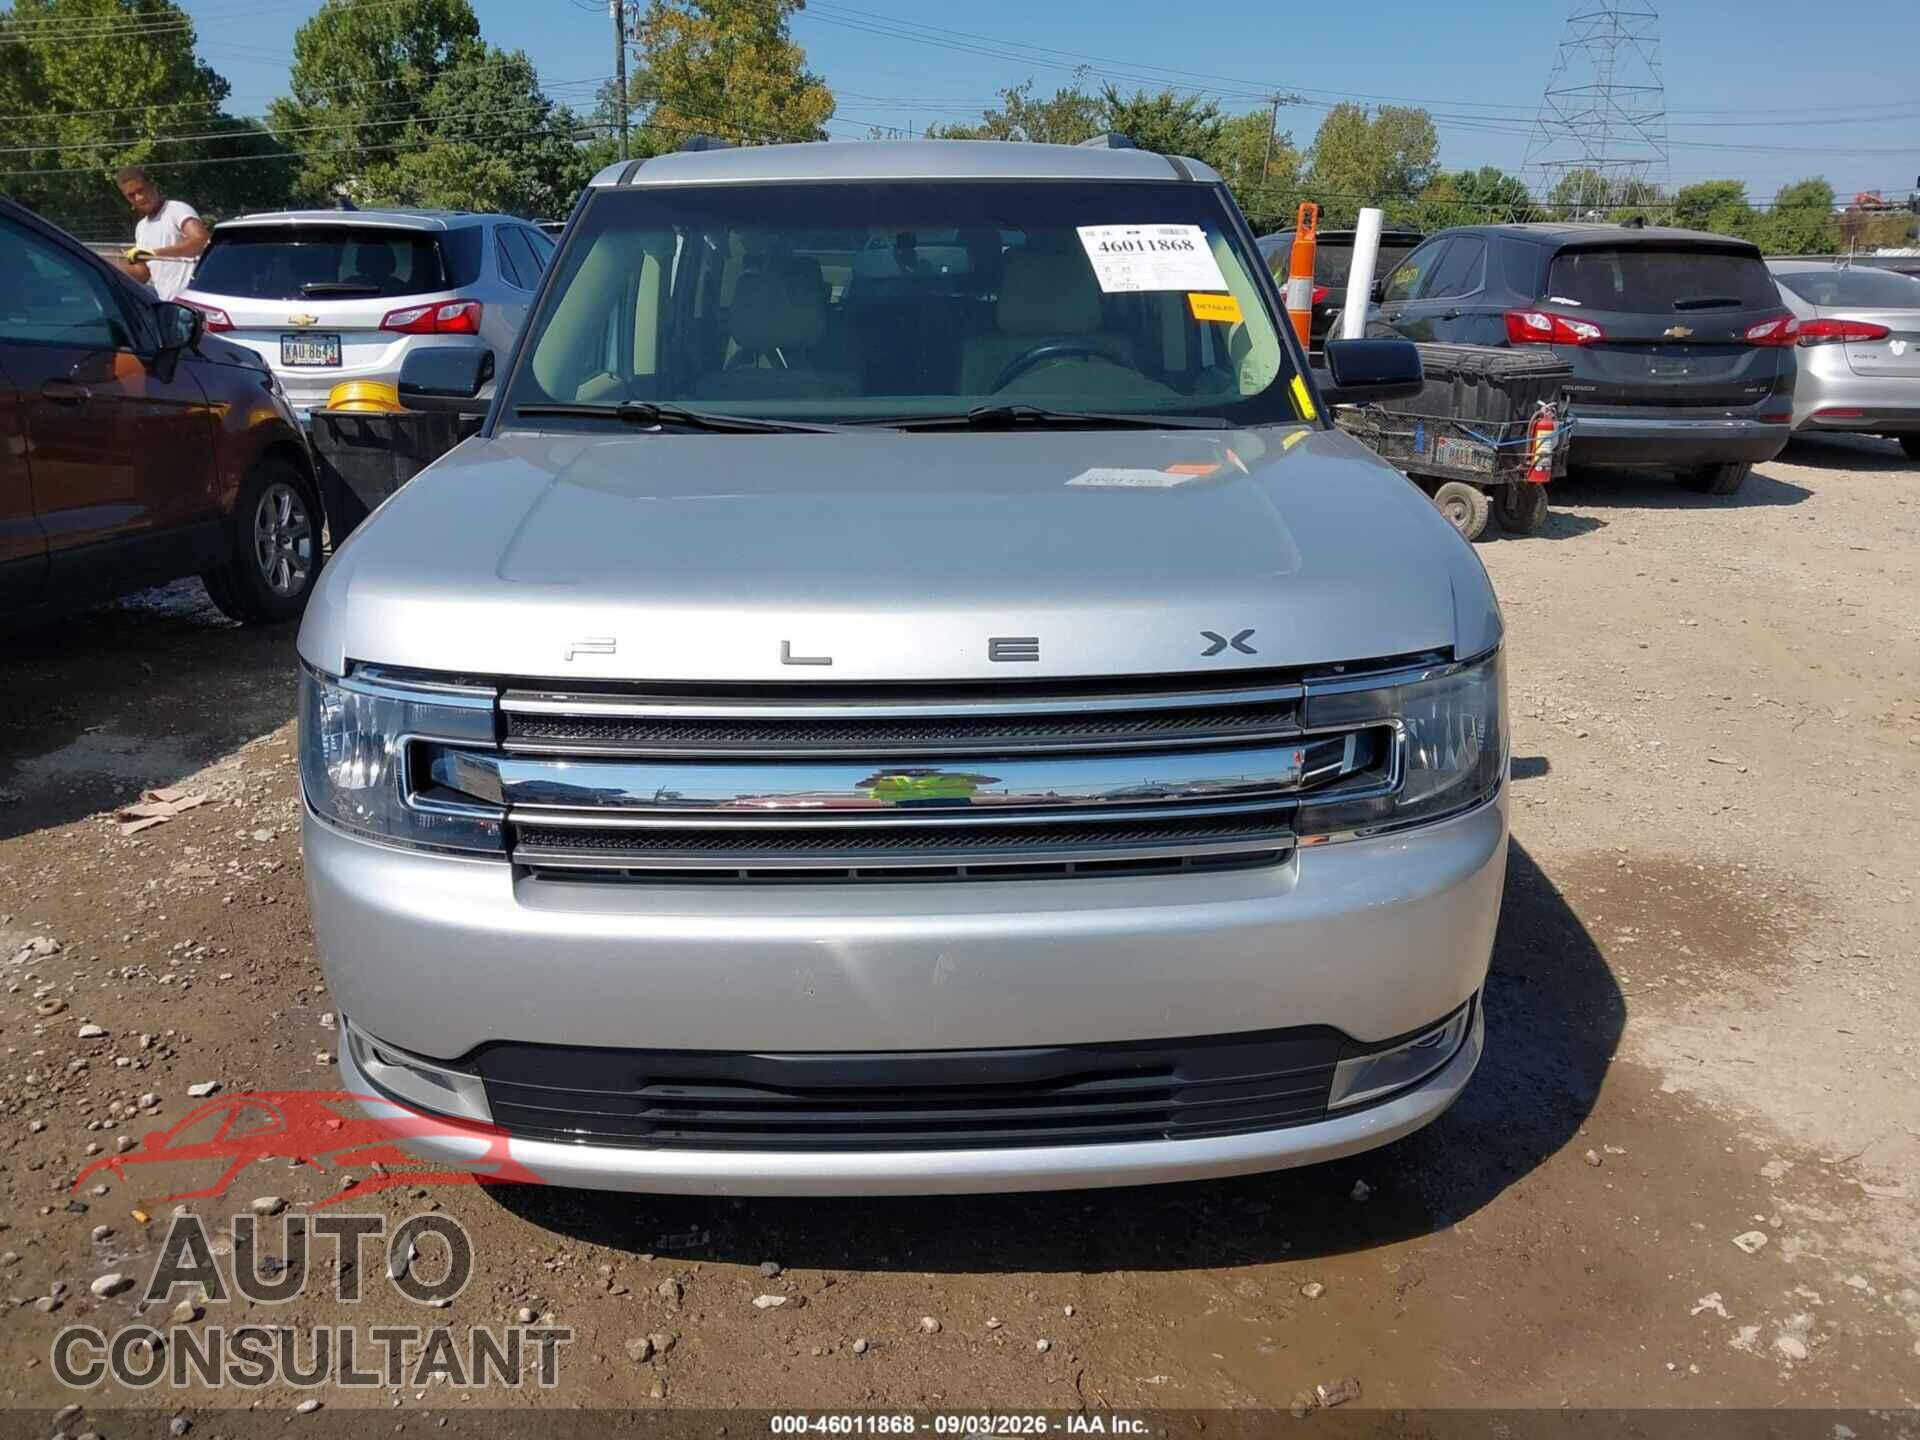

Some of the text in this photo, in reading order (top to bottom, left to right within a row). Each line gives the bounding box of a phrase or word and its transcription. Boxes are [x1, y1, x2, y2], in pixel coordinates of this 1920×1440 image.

[1098, 239, 1195, 253] 46011868
[285, 343, 336, 359] KAU 8643
[564, 629, 1256, 665] FLEX
